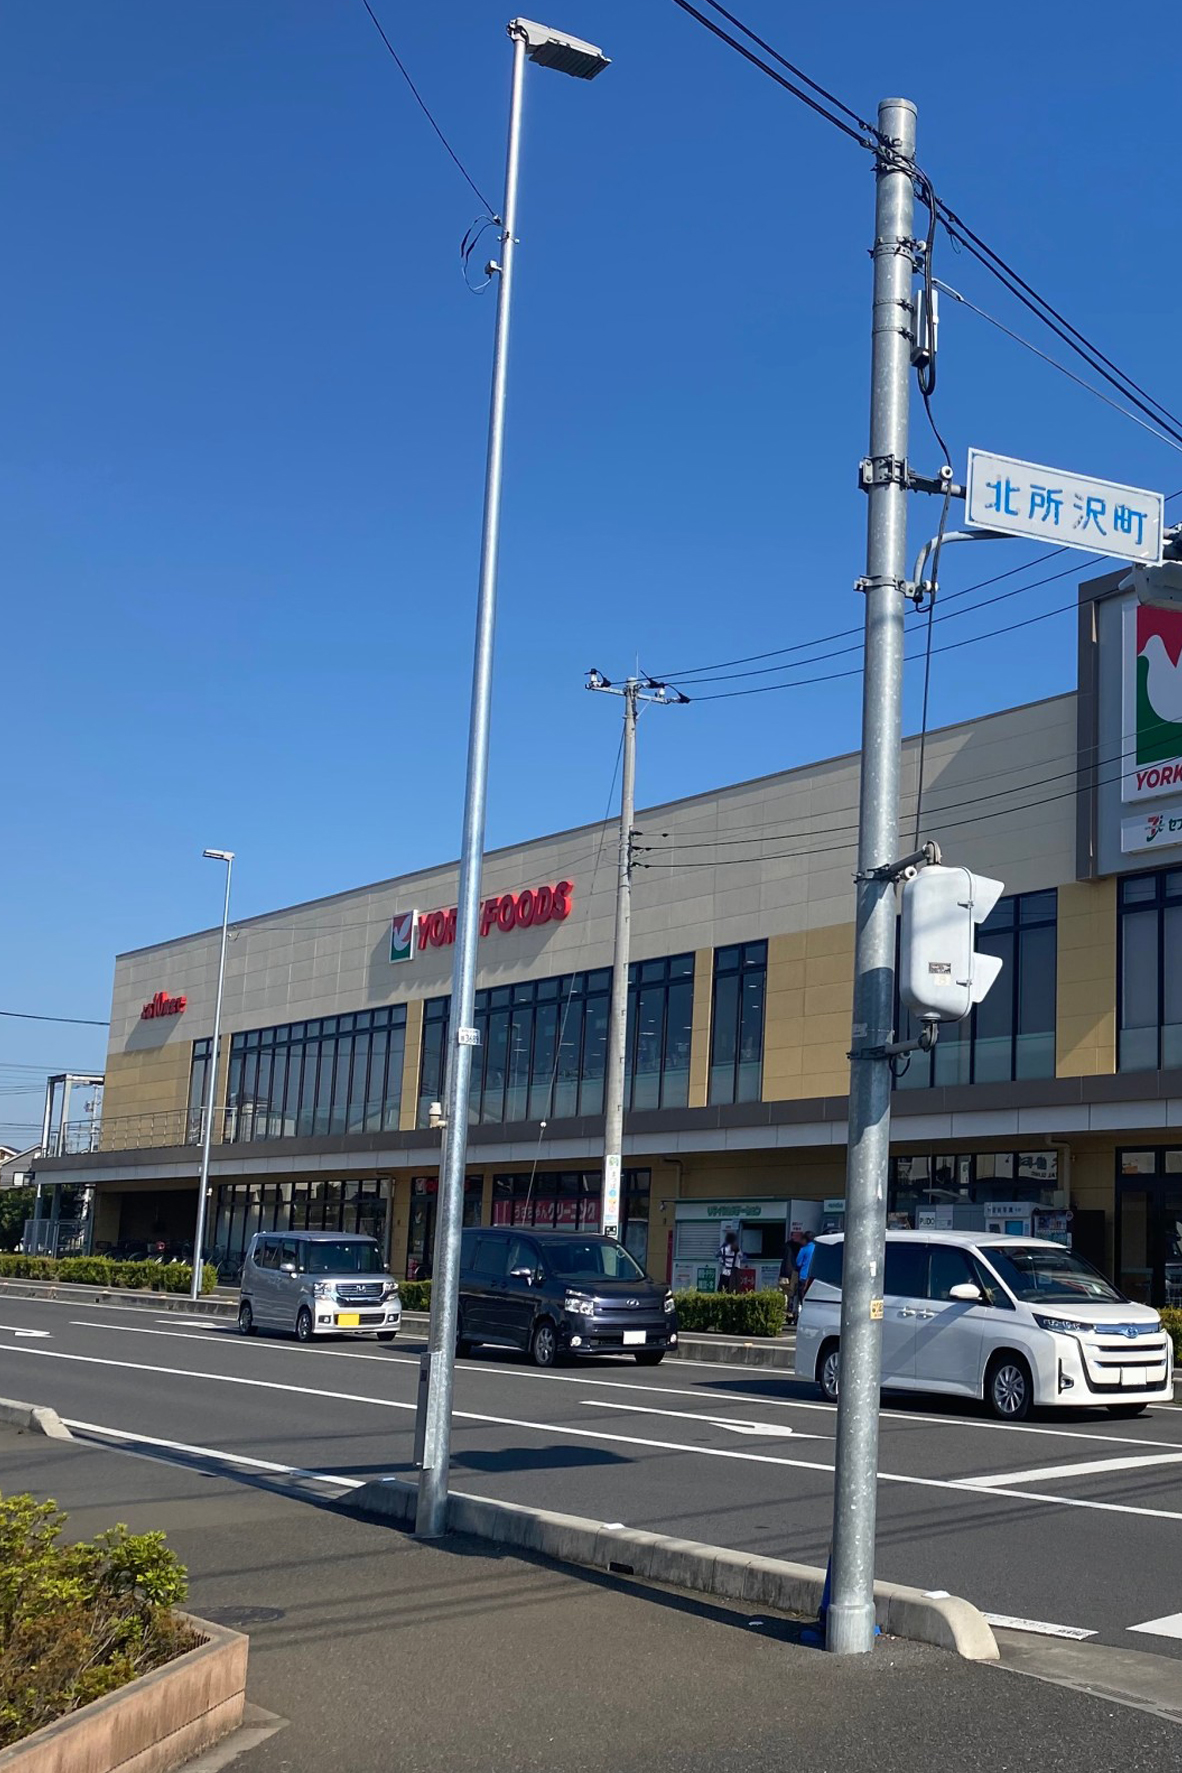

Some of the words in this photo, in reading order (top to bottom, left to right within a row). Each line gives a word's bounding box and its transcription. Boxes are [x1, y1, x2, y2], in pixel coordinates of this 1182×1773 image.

[985, 475, 1148, 545] 北所沢町
[480, 881, 574, 937] FOODS
[919, 1216, 935, 1226] PUDO
